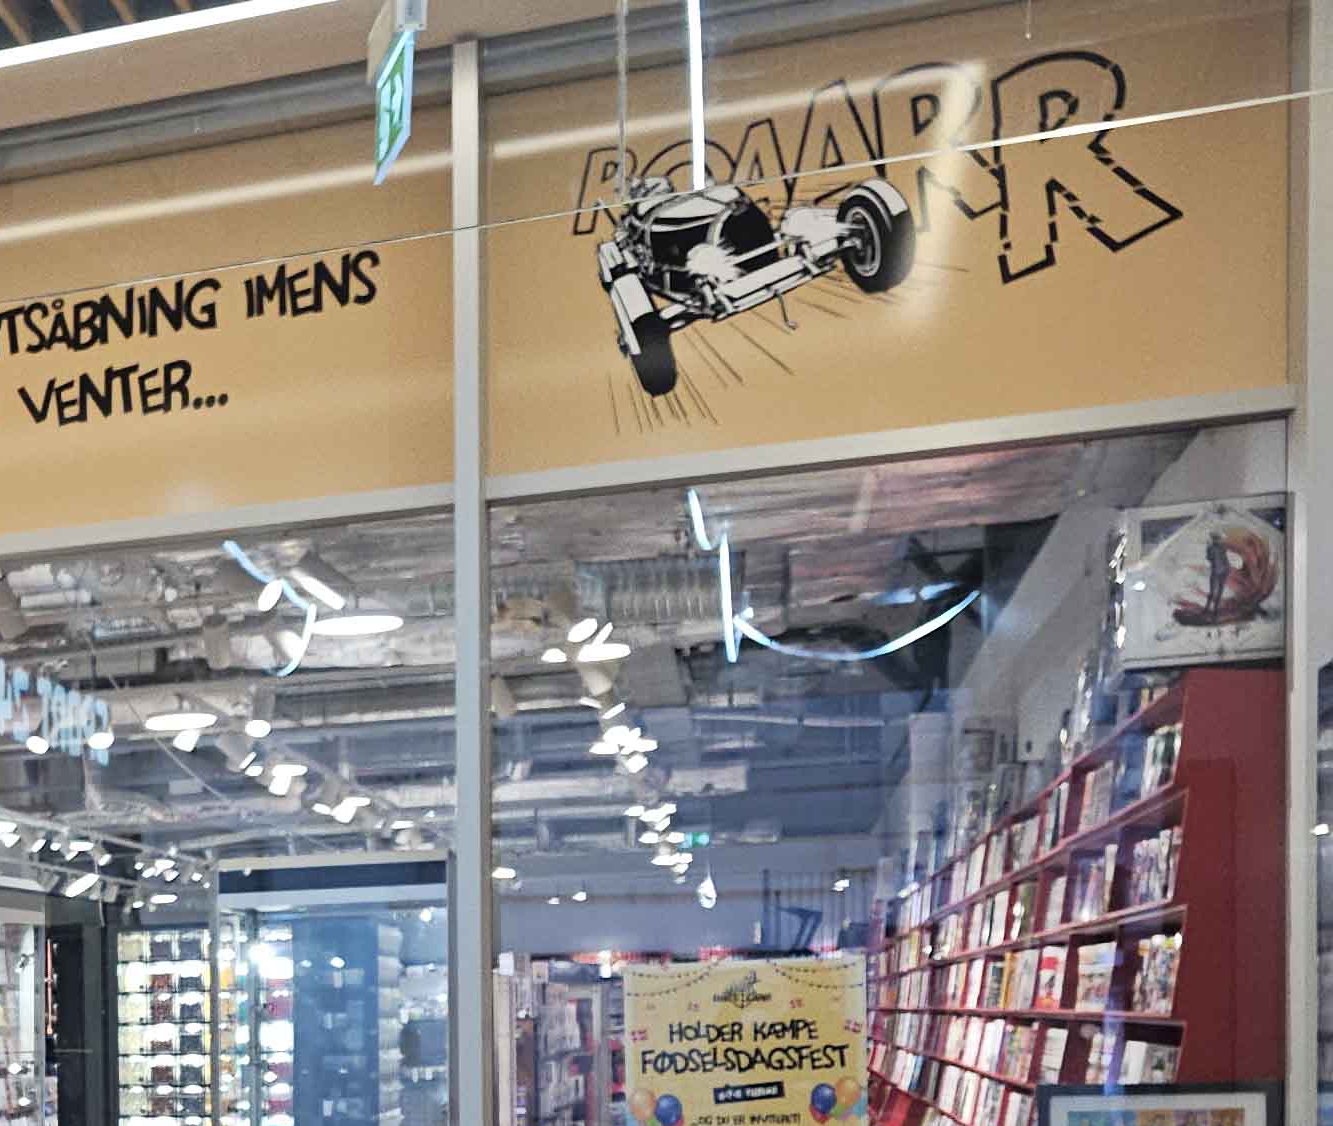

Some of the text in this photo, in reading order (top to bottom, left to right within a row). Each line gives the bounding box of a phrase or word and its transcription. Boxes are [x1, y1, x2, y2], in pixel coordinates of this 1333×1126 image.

[244, 249, 380, 318] IMENS
[18, 359, 228, 427] VENTER...
[669, 1019, 819, 1044] HOLDER KÆMPE
[641, 1044, 850, 1075] FØDSELSDAGSFEST
